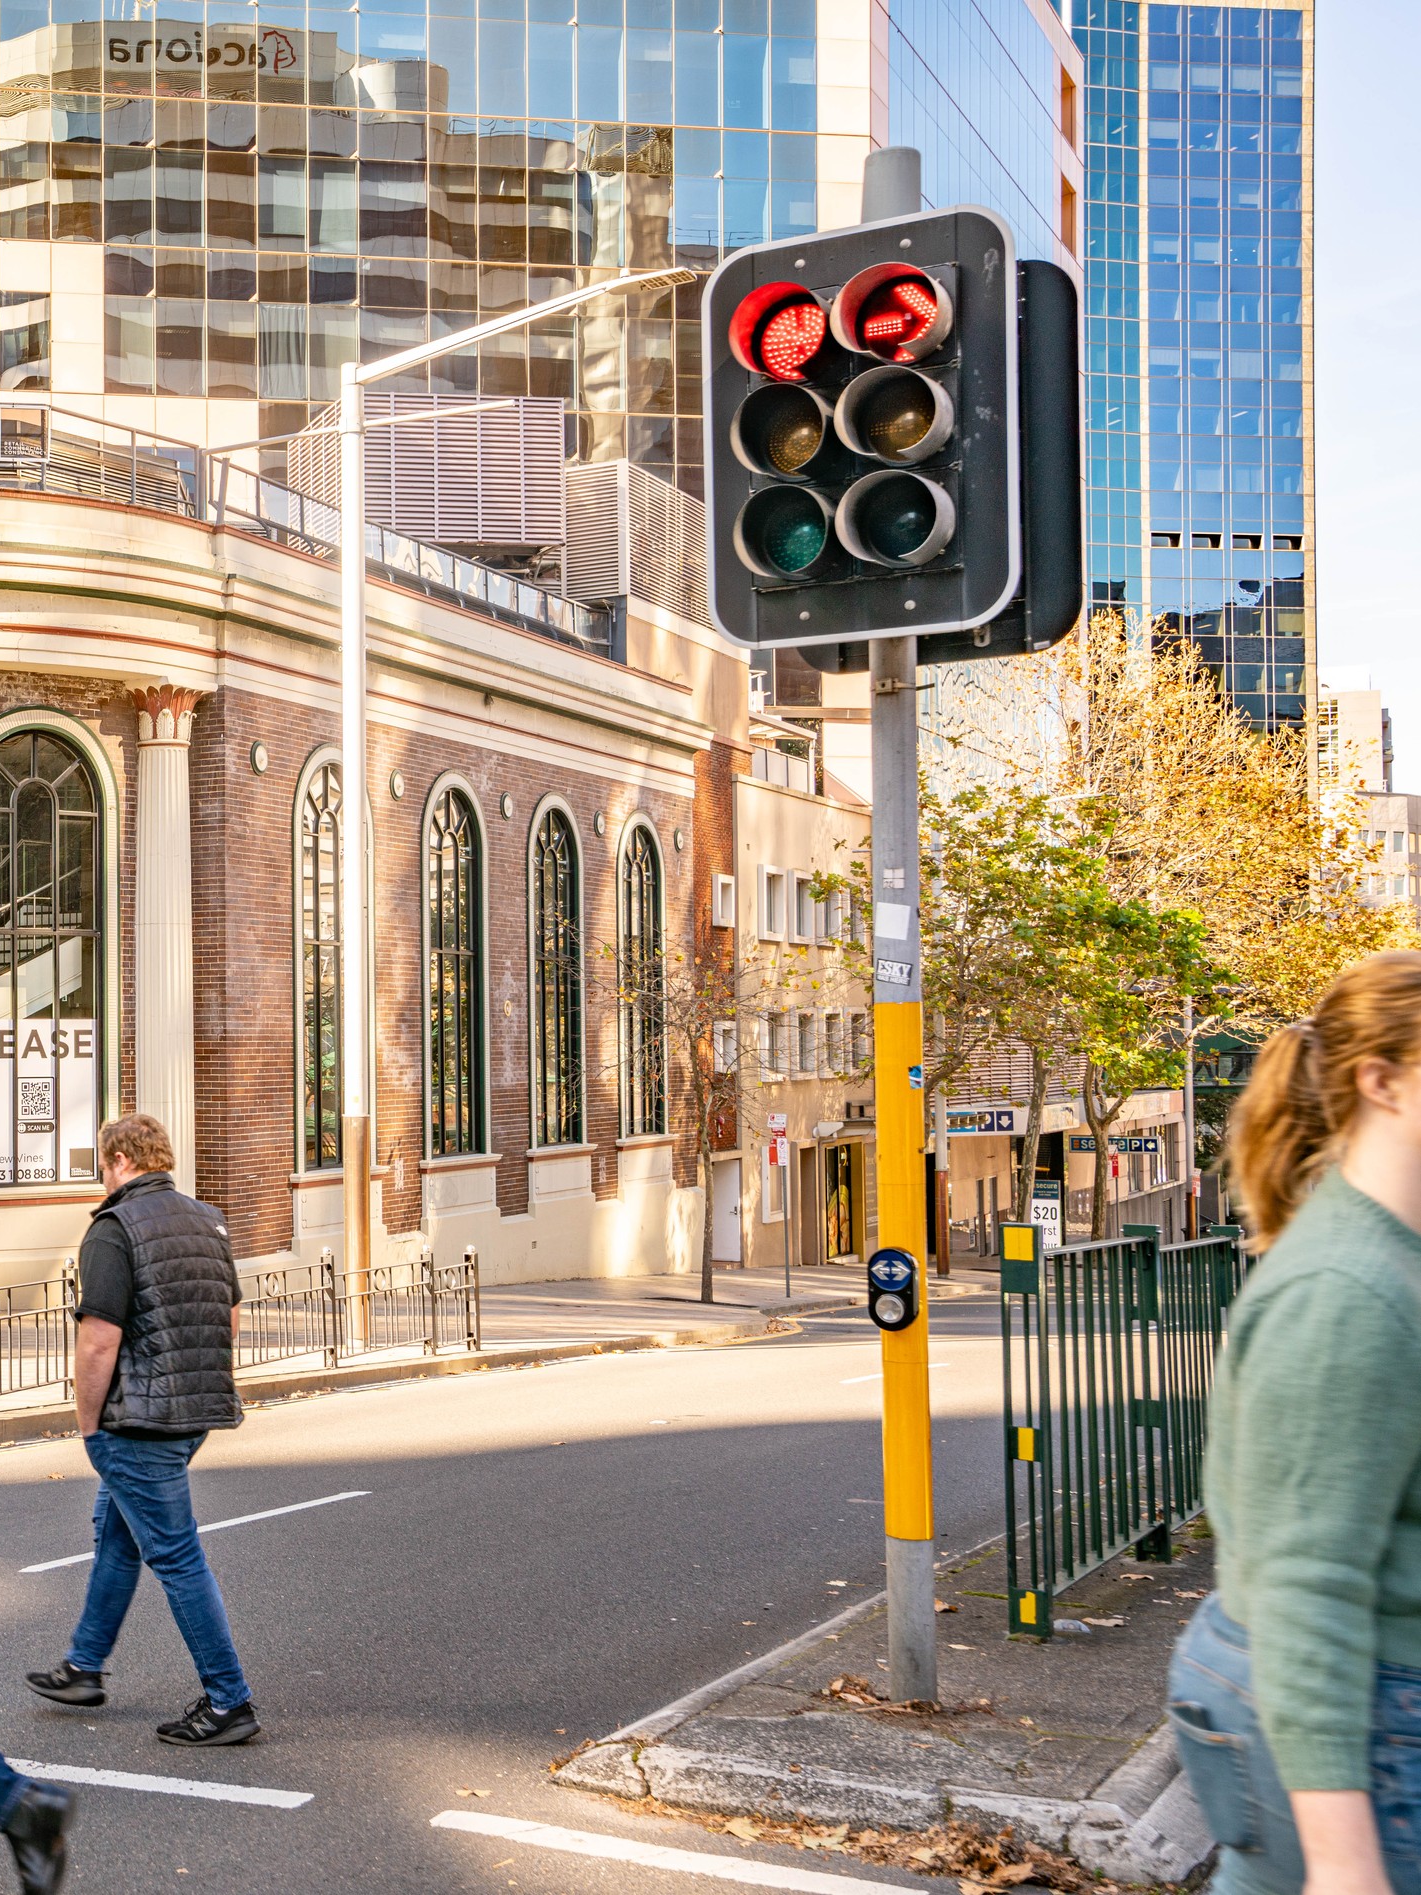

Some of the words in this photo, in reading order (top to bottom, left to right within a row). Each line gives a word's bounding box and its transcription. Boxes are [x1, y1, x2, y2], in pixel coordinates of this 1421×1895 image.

[878, 960, 912, 978] ESKY
[1131, 1140, 1140, 1150] P
[17, 1152, 44, 1163] Vines
[8, 1168, 32, 1181] 108
[33, 1167, 55, 1179] 880
[1033, 1205, 1058, 1221] $20
